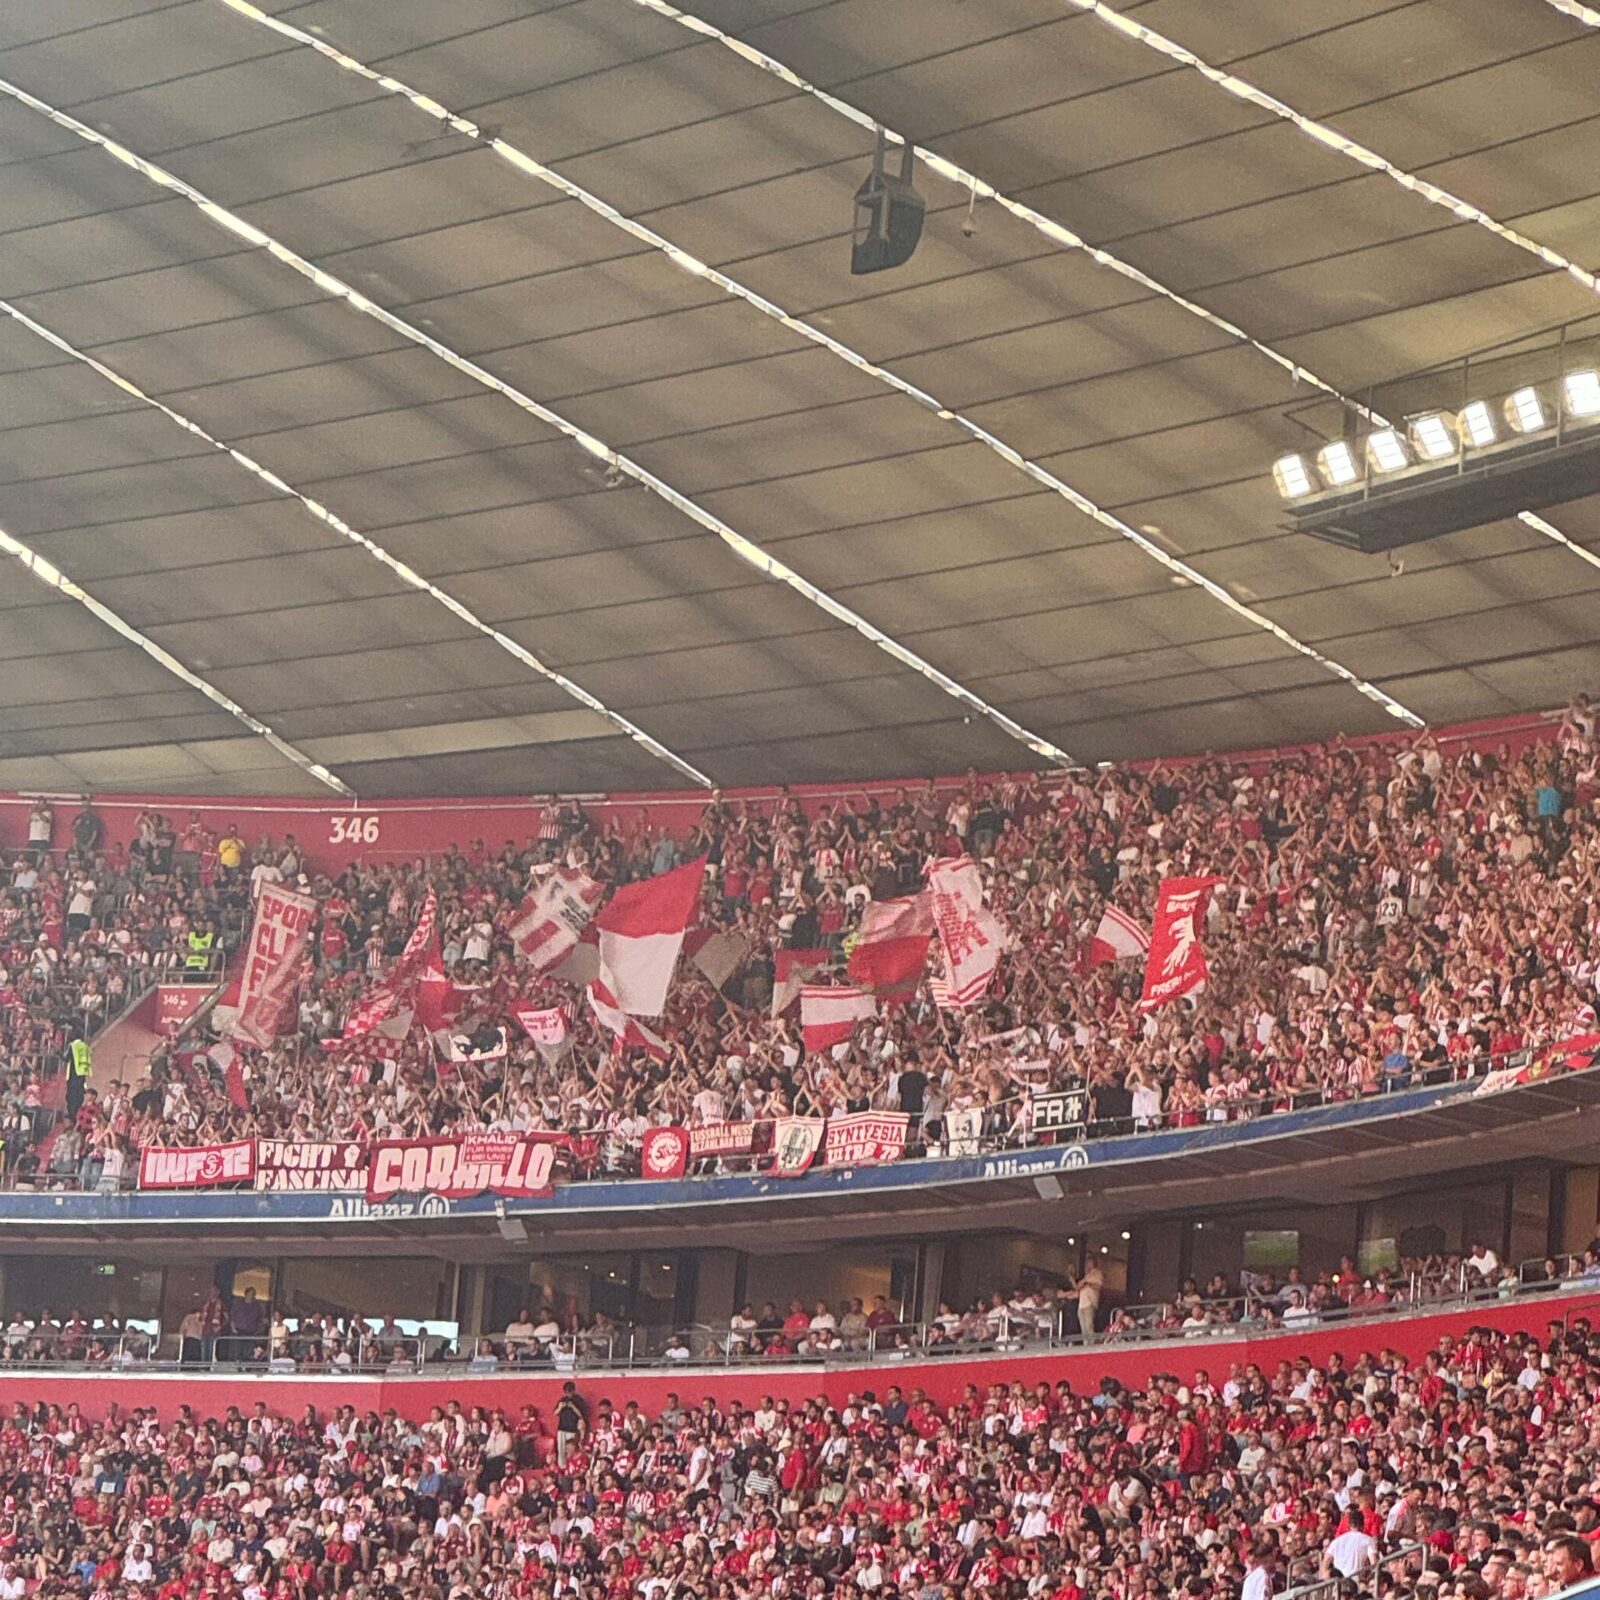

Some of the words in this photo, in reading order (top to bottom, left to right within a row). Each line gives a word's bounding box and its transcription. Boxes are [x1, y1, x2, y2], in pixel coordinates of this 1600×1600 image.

[328, 816, 379, 843] 346
[163, 994, 179, 1005] 346
[468, 1134, 517, 1145] KHALID
[690, 1125, 729, 1142] FUSSBALL
[731, 1124, 753, 1137] MUSS
[690, 1136, 734, 1153] BEZAHLBAR
[258, 1141, 337, 1169] FIGHT
[984, 1159, 1056, 1178] Allianz
[329, 1199, 414, 1218] Allianz
